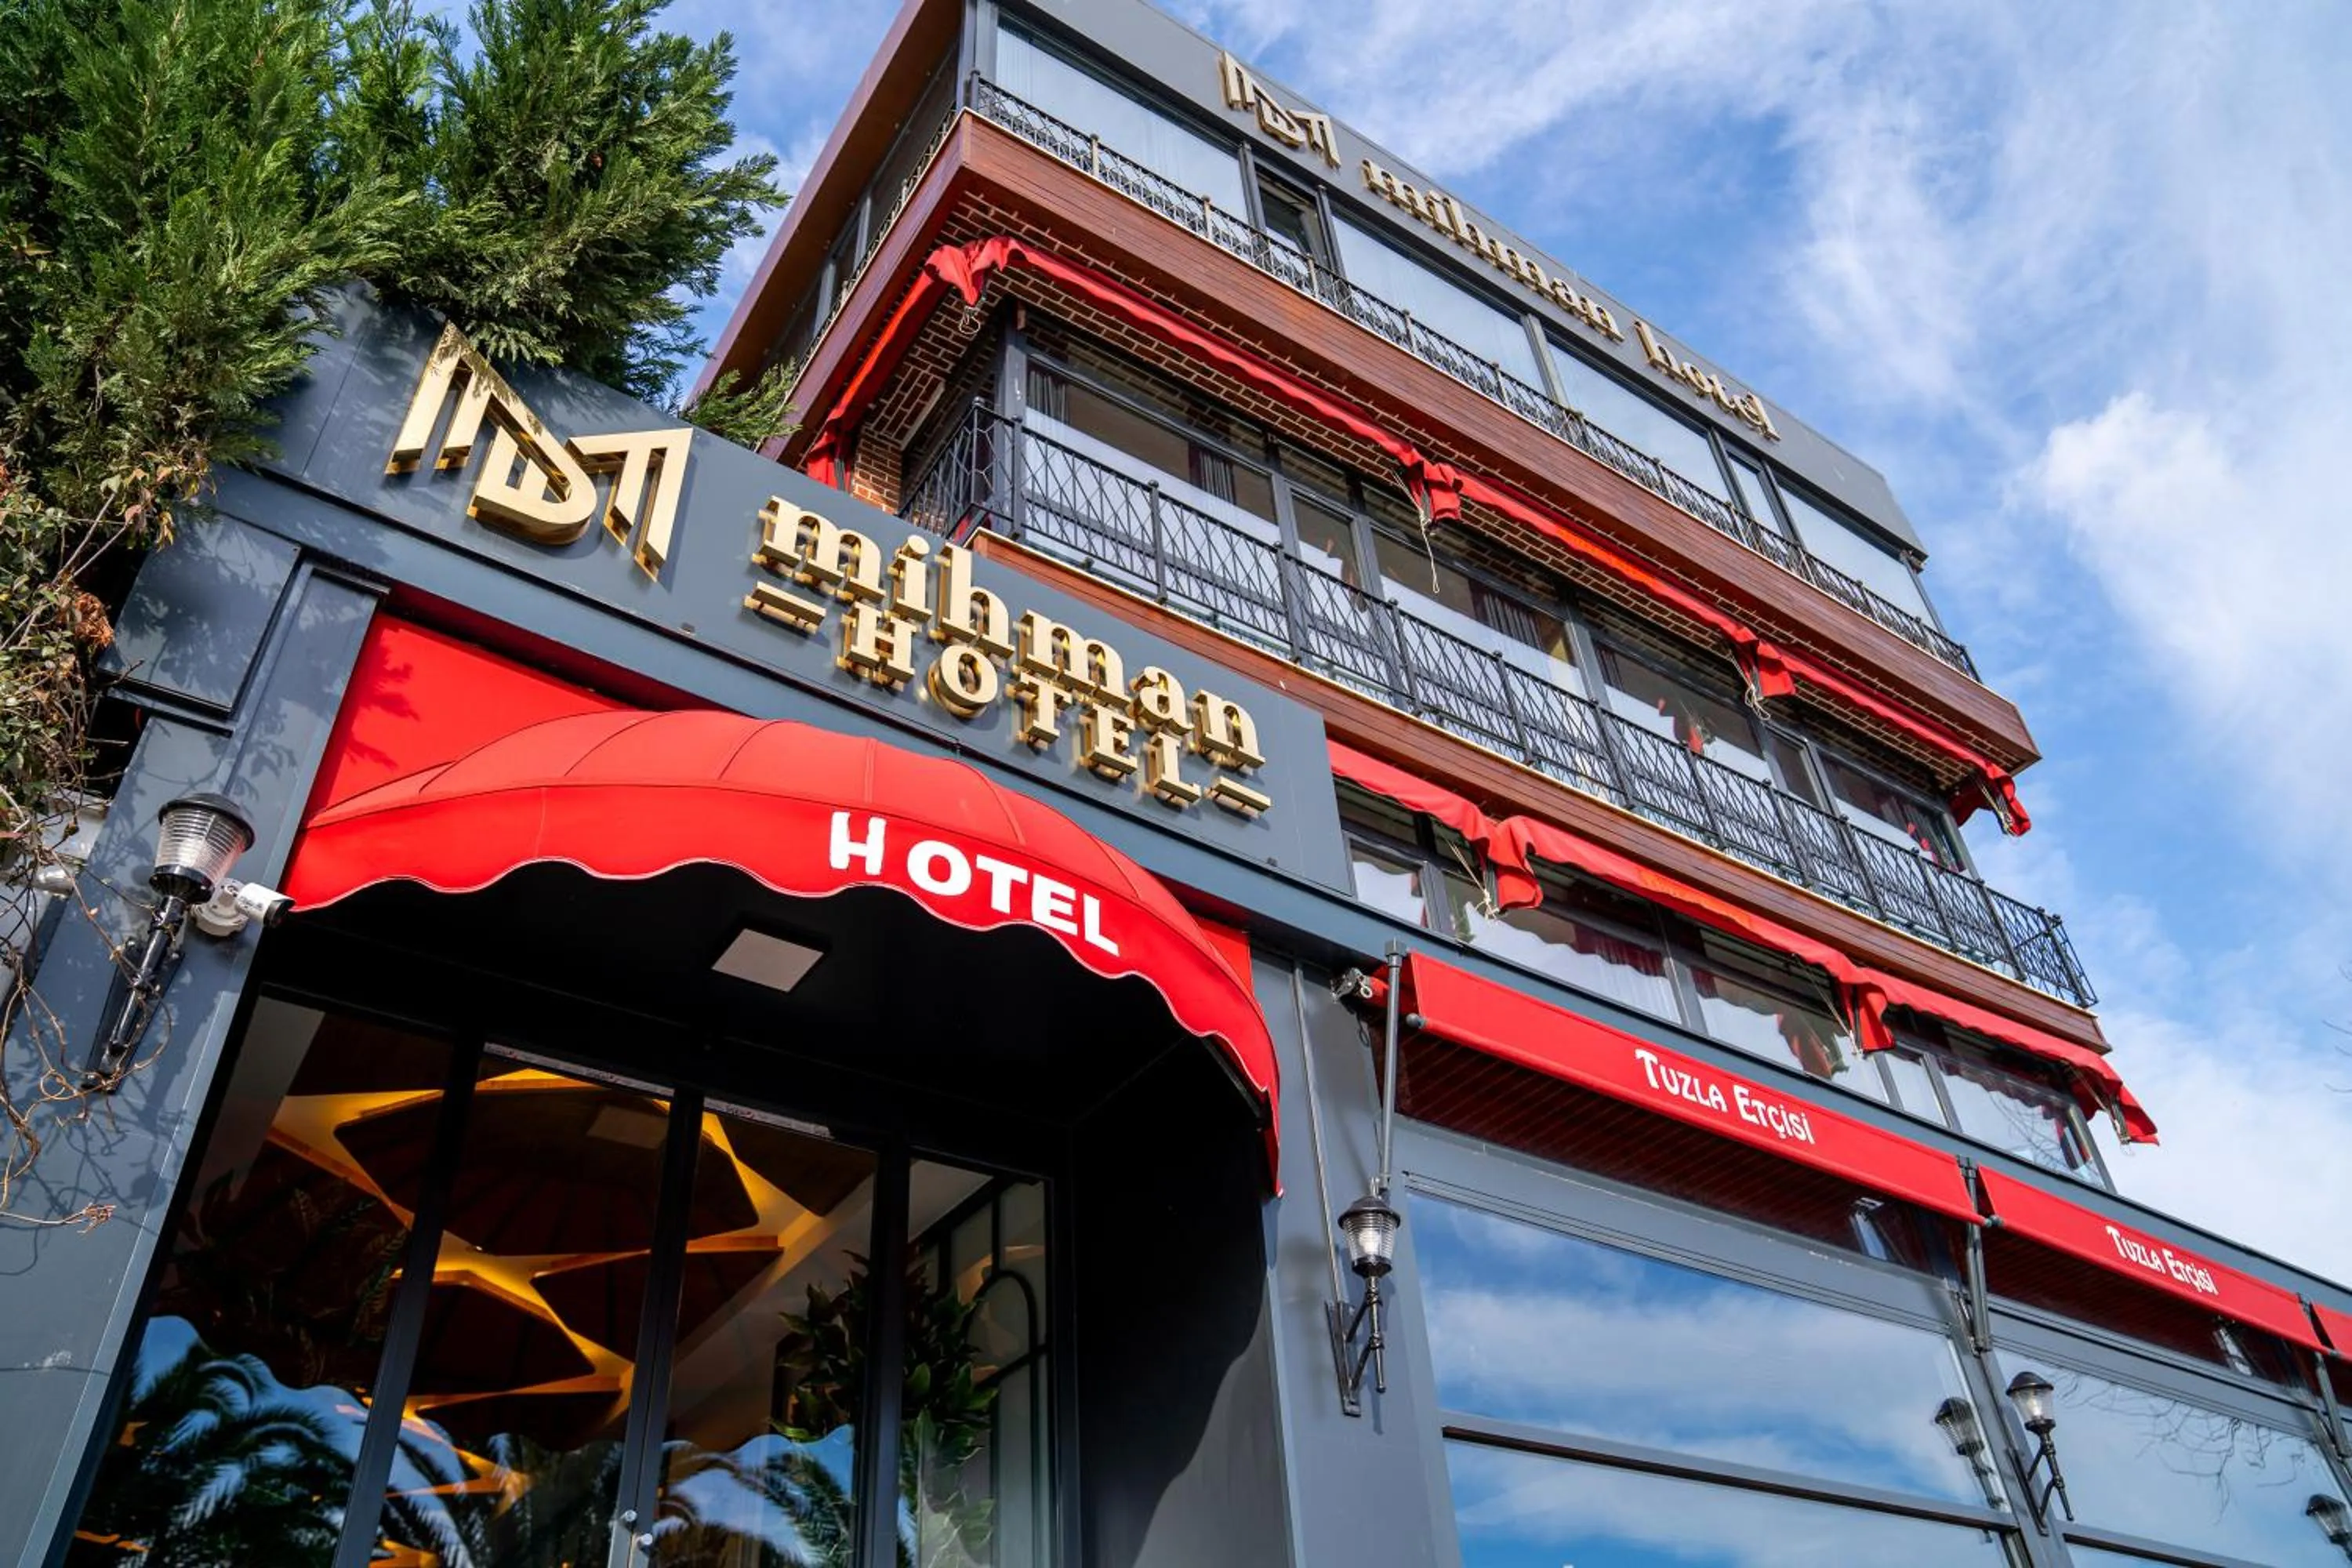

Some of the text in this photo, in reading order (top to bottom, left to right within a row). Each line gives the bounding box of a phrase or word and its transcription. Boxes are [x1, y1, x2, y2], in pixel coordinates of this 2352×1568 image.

[1362, 158, 1781, 441] mihman hotel
[753, 495, 1266, 770] mihman
[837, 603, 1201, 806] HOTEL
[829, 811, 1120, 957] HOTEL
[1635, 1048, 1728, 1112] TUZLA
